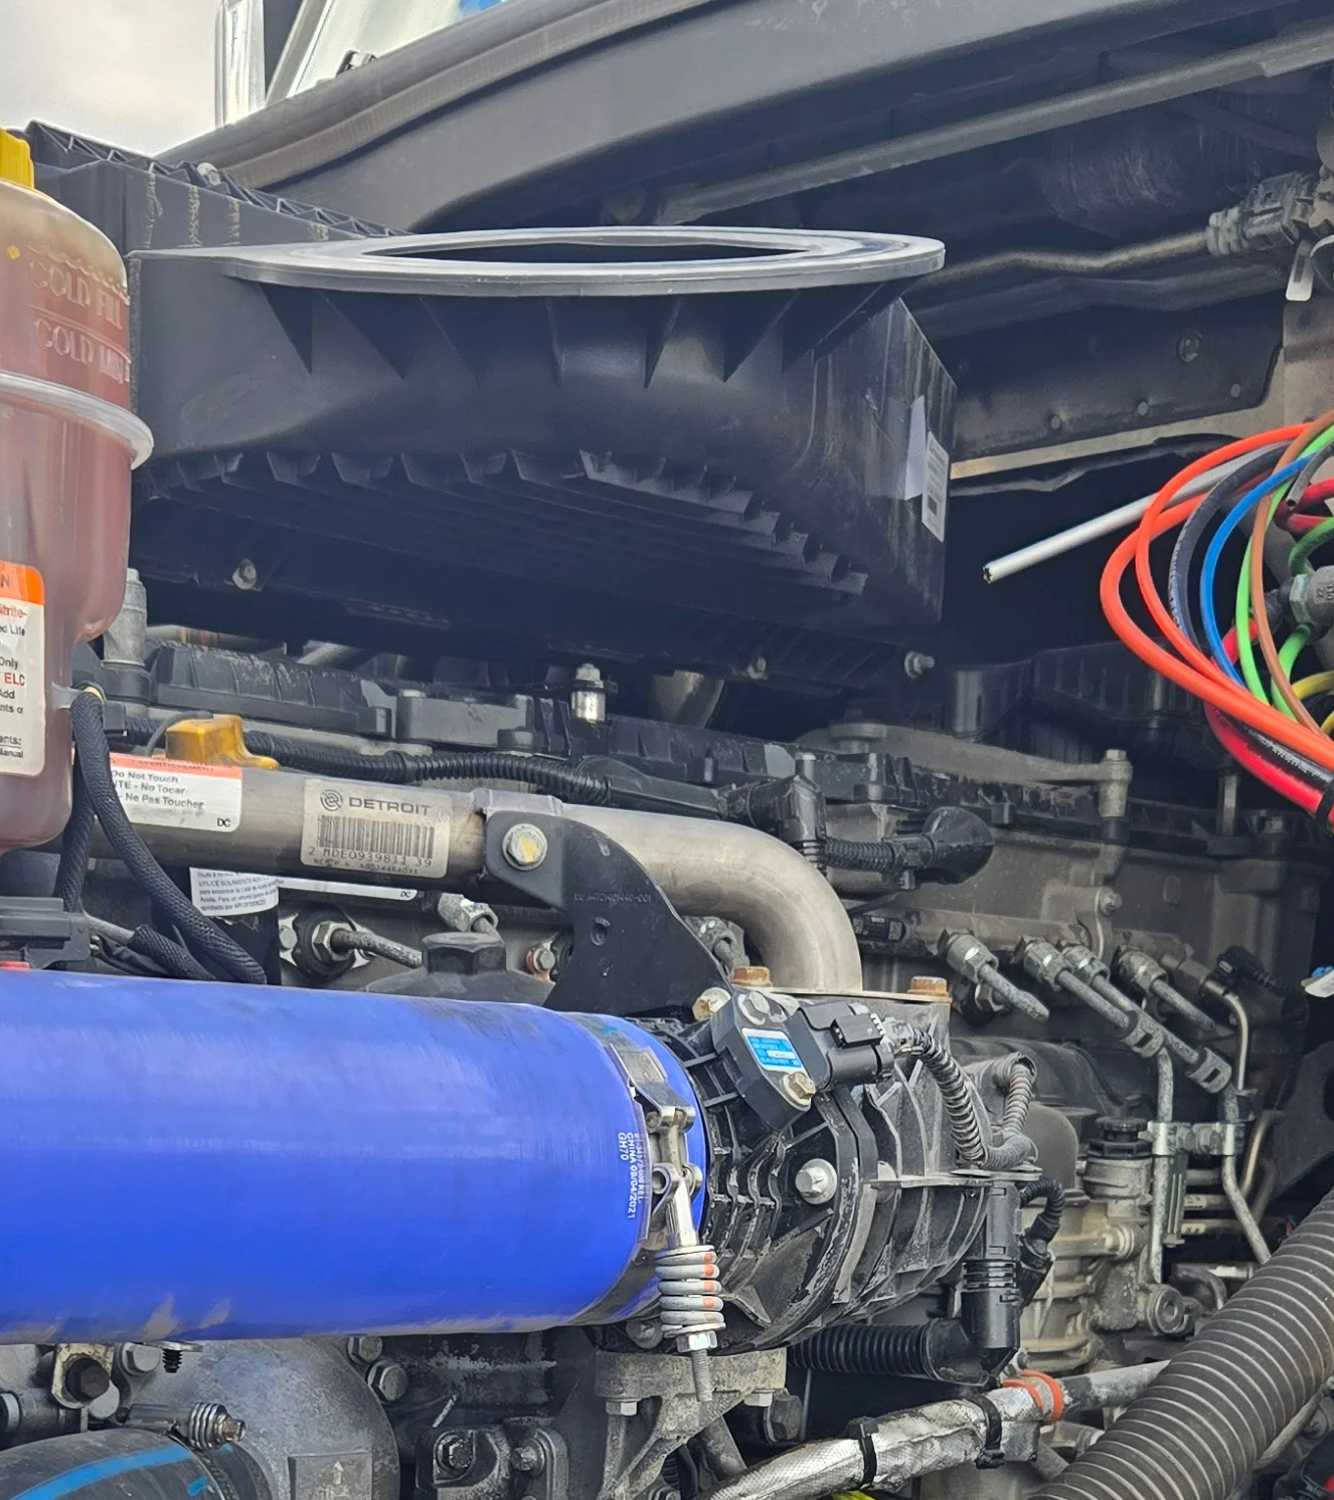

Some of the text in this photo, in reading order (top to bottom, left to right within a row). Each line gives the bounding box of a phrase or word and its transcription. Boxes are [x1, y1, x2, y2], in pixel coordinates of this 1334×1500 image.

[28, 258, 91, 307] COLD
[33, 318, 93, 365] COLD
[4, 673, 25, 686] ELC
[128, 771, 146, 780] Not
[148, 774, 179, 783] Touch
[141, 783, 186, 794] No Tocar
[125, 793, 204, 809] Ne Pas Toucher
[349, 797, 432, 816] DETROIT
[217, 818, 231, 827] DC
[617, 1132, 628, 1160] GH70
[626, 1132, 637, 1162] CHINA
